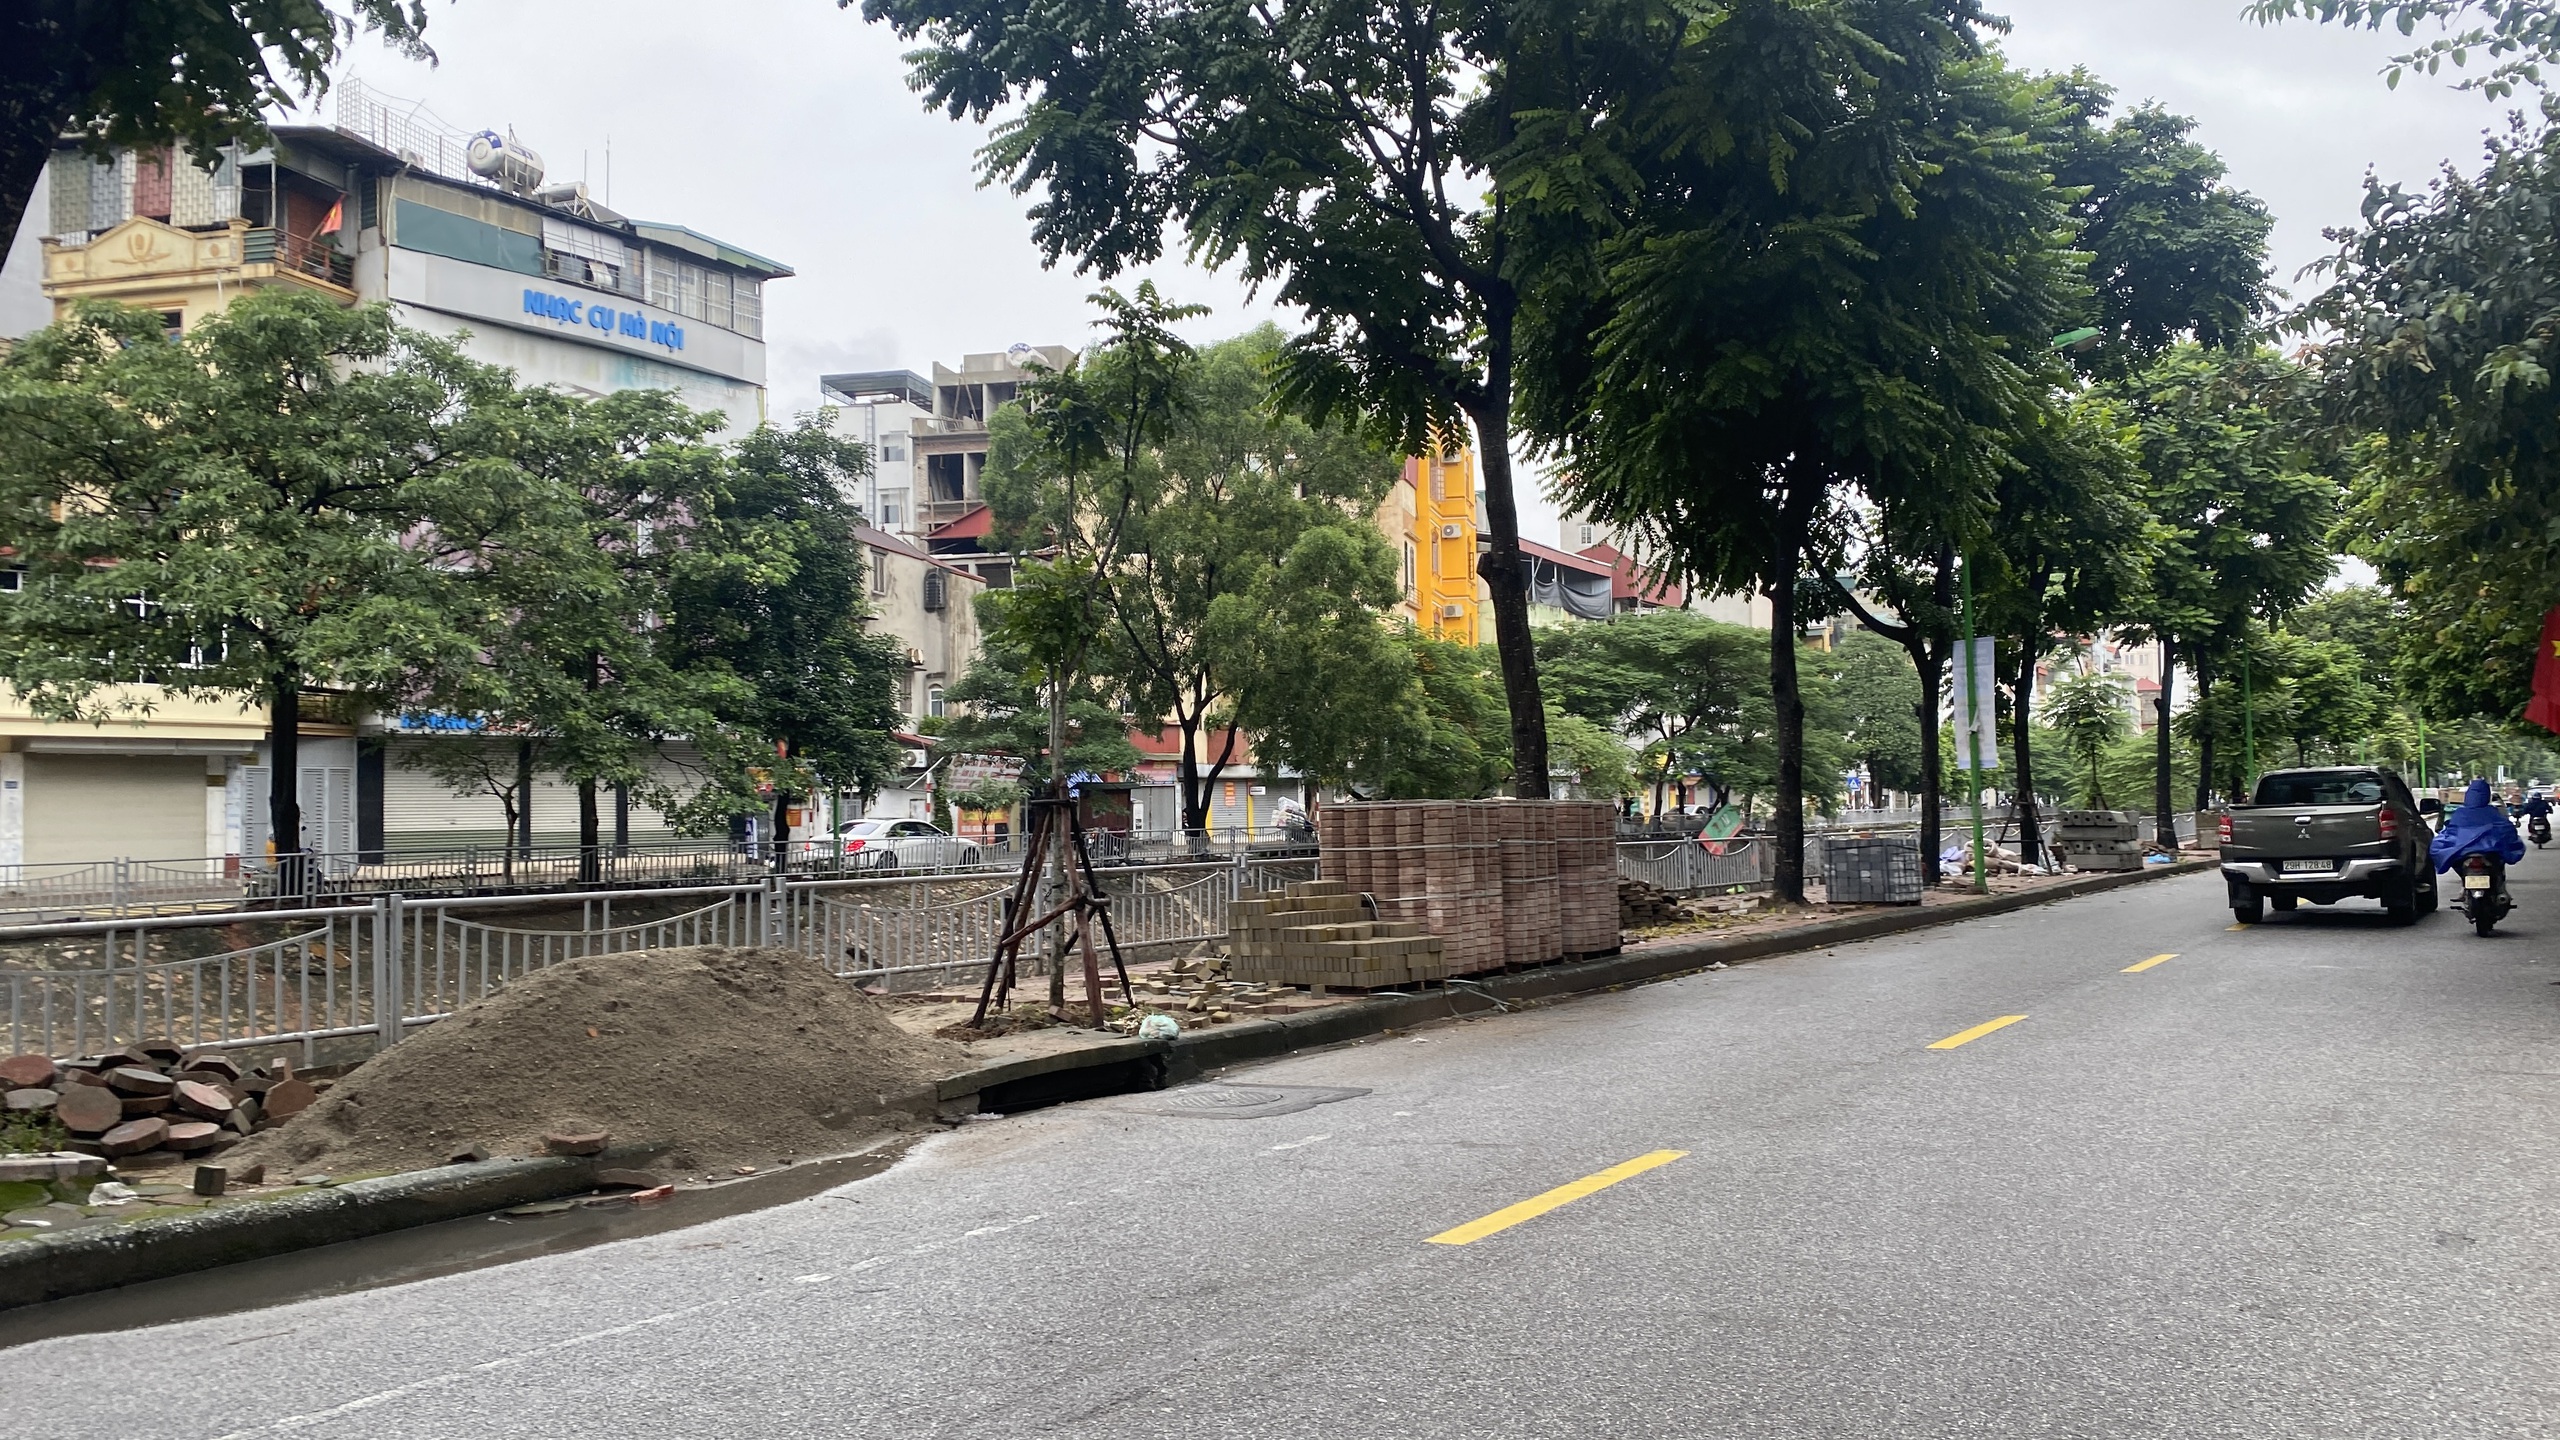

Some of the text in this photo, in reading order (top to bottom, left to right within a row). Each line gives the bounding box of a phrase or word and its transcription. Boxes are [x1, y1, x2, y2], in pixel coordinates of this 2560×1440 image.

[523, 289, 684, 353] NHẠC CỤ HÀ NỘI
